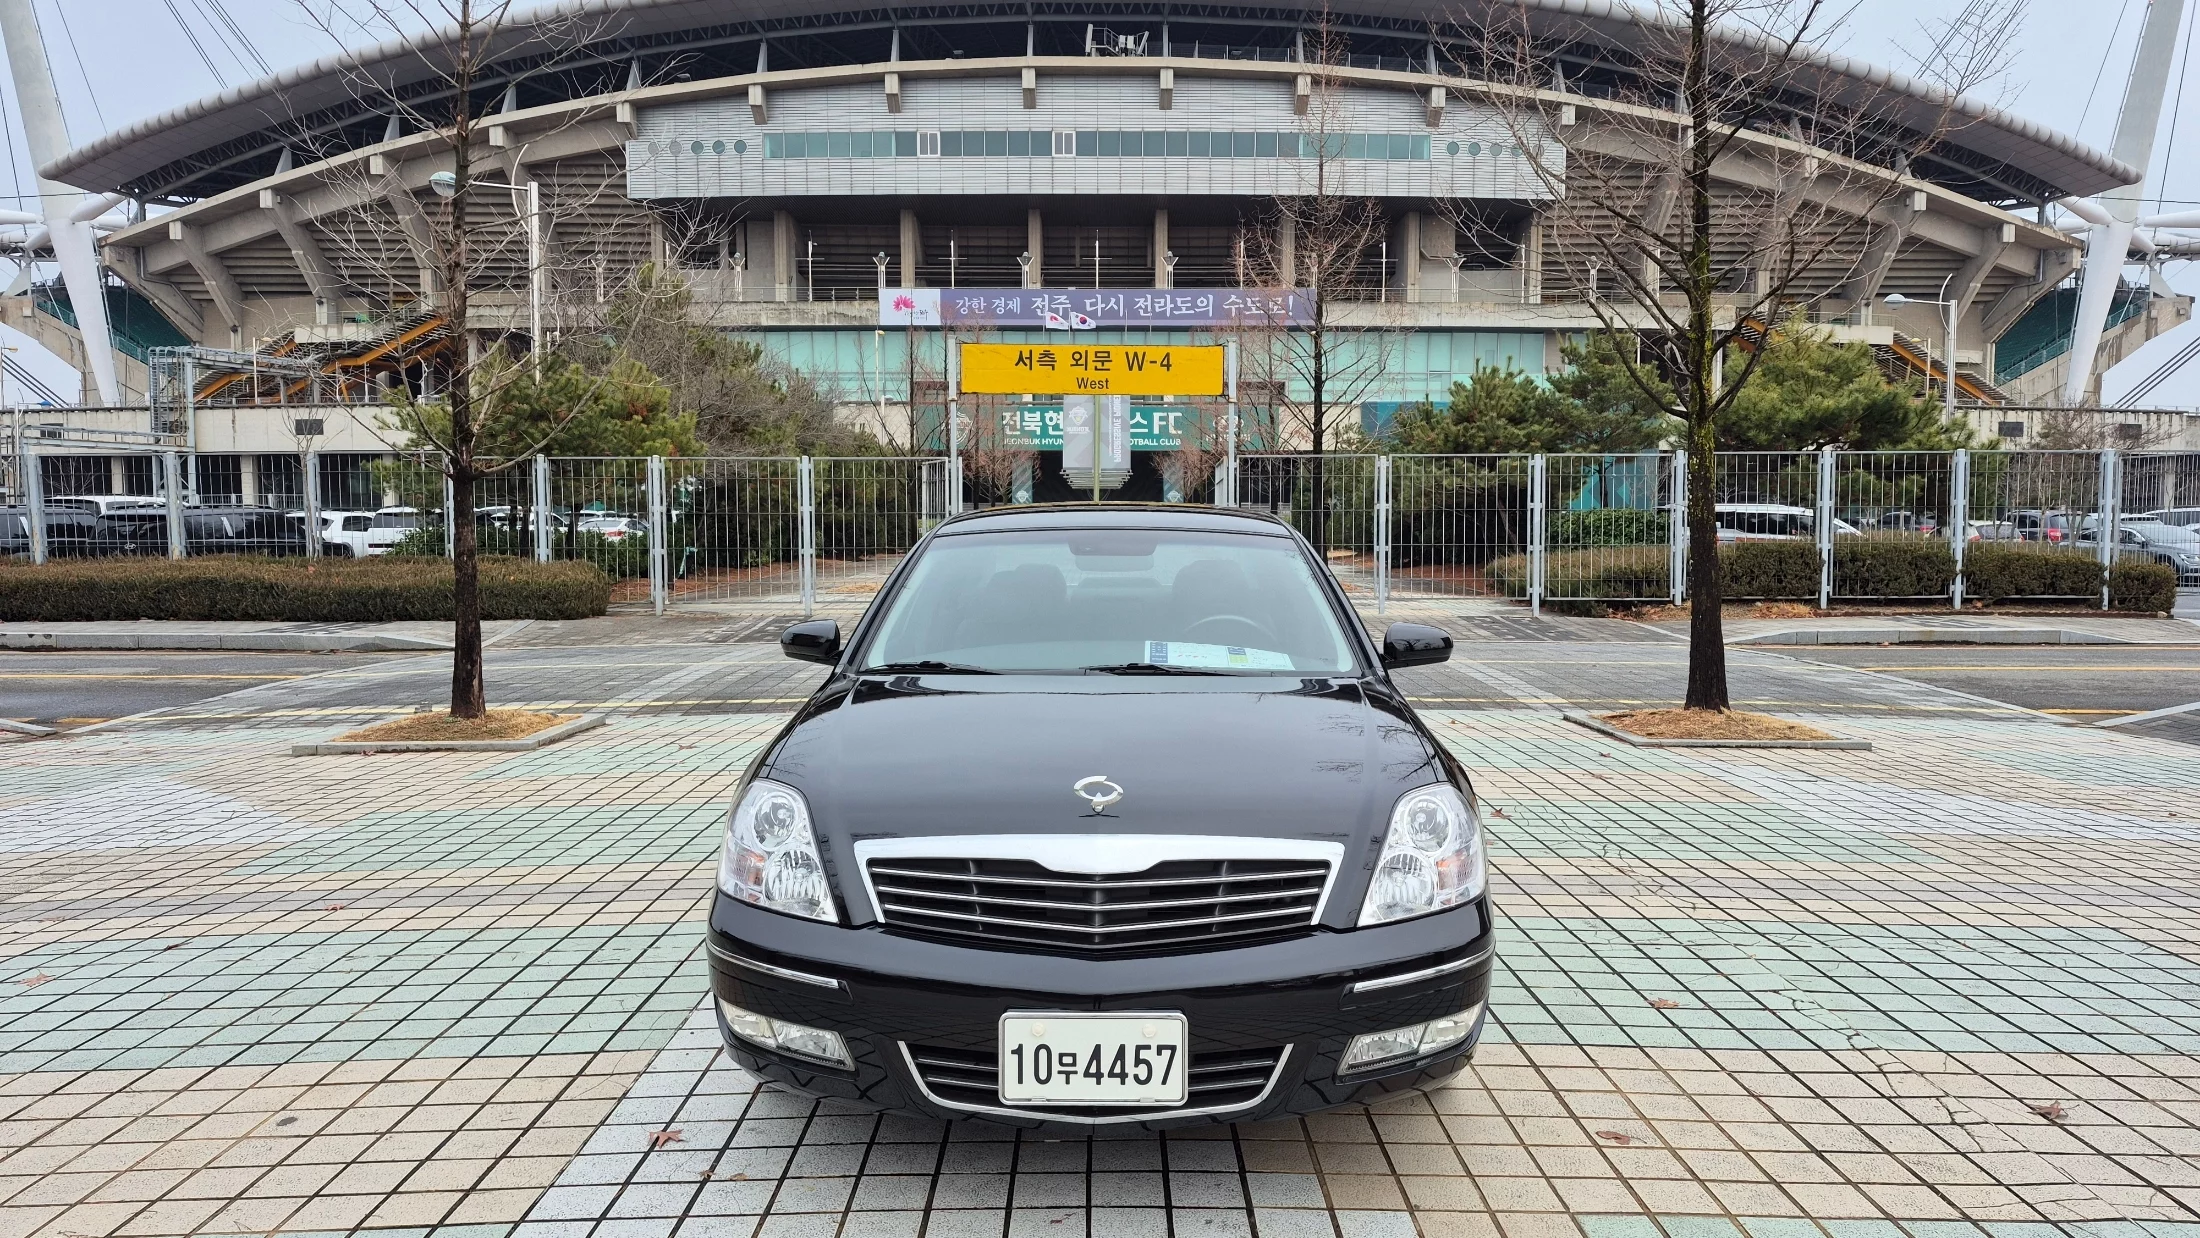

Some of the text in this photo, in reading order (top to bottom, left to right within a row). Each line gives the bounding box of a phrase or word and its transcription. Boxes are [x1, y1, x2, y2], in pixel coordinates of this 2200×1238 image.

[955, 296, 987, 315] 강한
[991, 296, 1021, 315] 경제
[1031, 294, 1072, 317] 전주
[1083, 294, 1124, 317] 다시
[1133, 294, 1214, 318] 전라도의
[1014, 349, 1173, 372] 서측 외문 W-4
[1076, 377, 1110, 390] West
[1002, 410, 1064, 435] 전북현
[1129, 438, 1159, 446] OTBALL
[1159, 438, 1182, 446] CLUB
[1010, 1043, 1178, 1086] 10무4457
